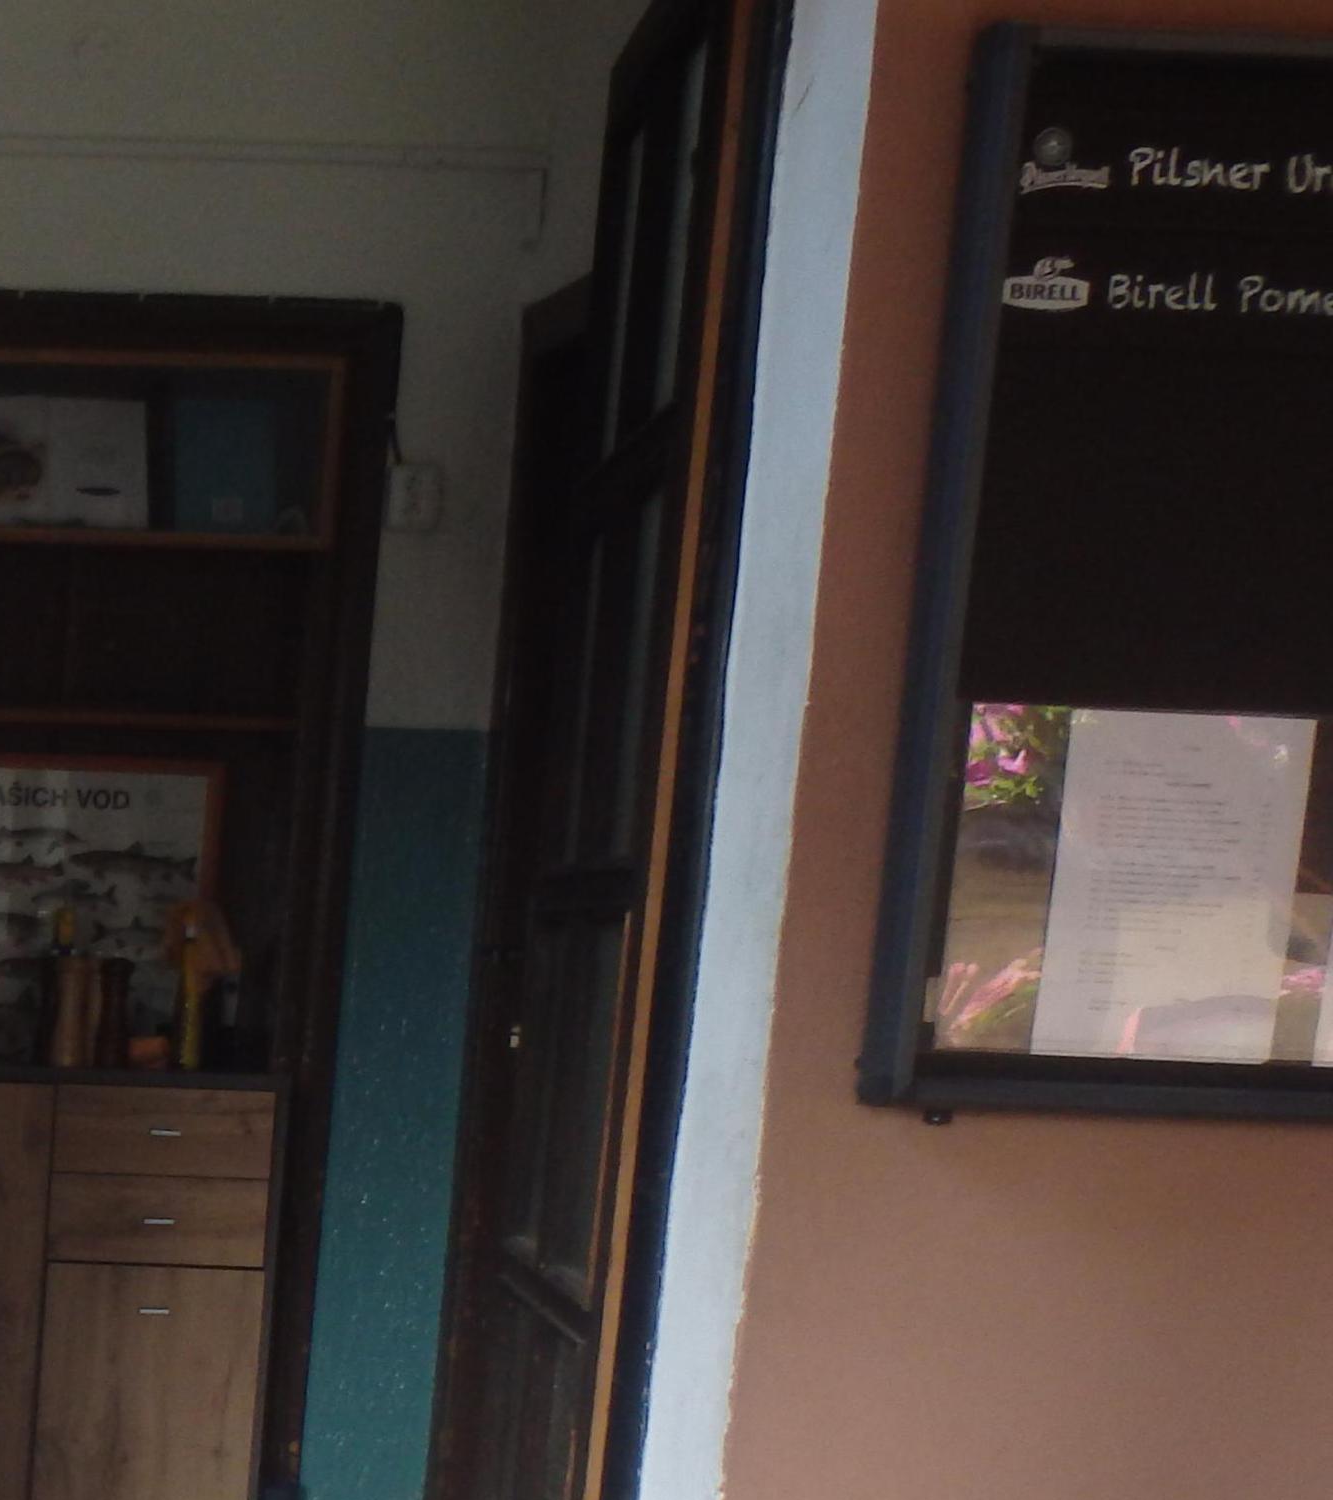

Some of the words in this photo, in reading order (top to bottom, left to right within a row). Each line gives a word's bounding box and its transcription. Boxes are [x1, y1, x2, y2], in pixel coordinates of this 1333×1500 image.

[1129, 145, 1272, 191] Pilsner
[1286, 152, 1333, 194] Ur
[1010, 281, 1083, 302] BIRELL
[1108, 272, 1217, 312] Birell
[76, 788, 132, 811] VOD
